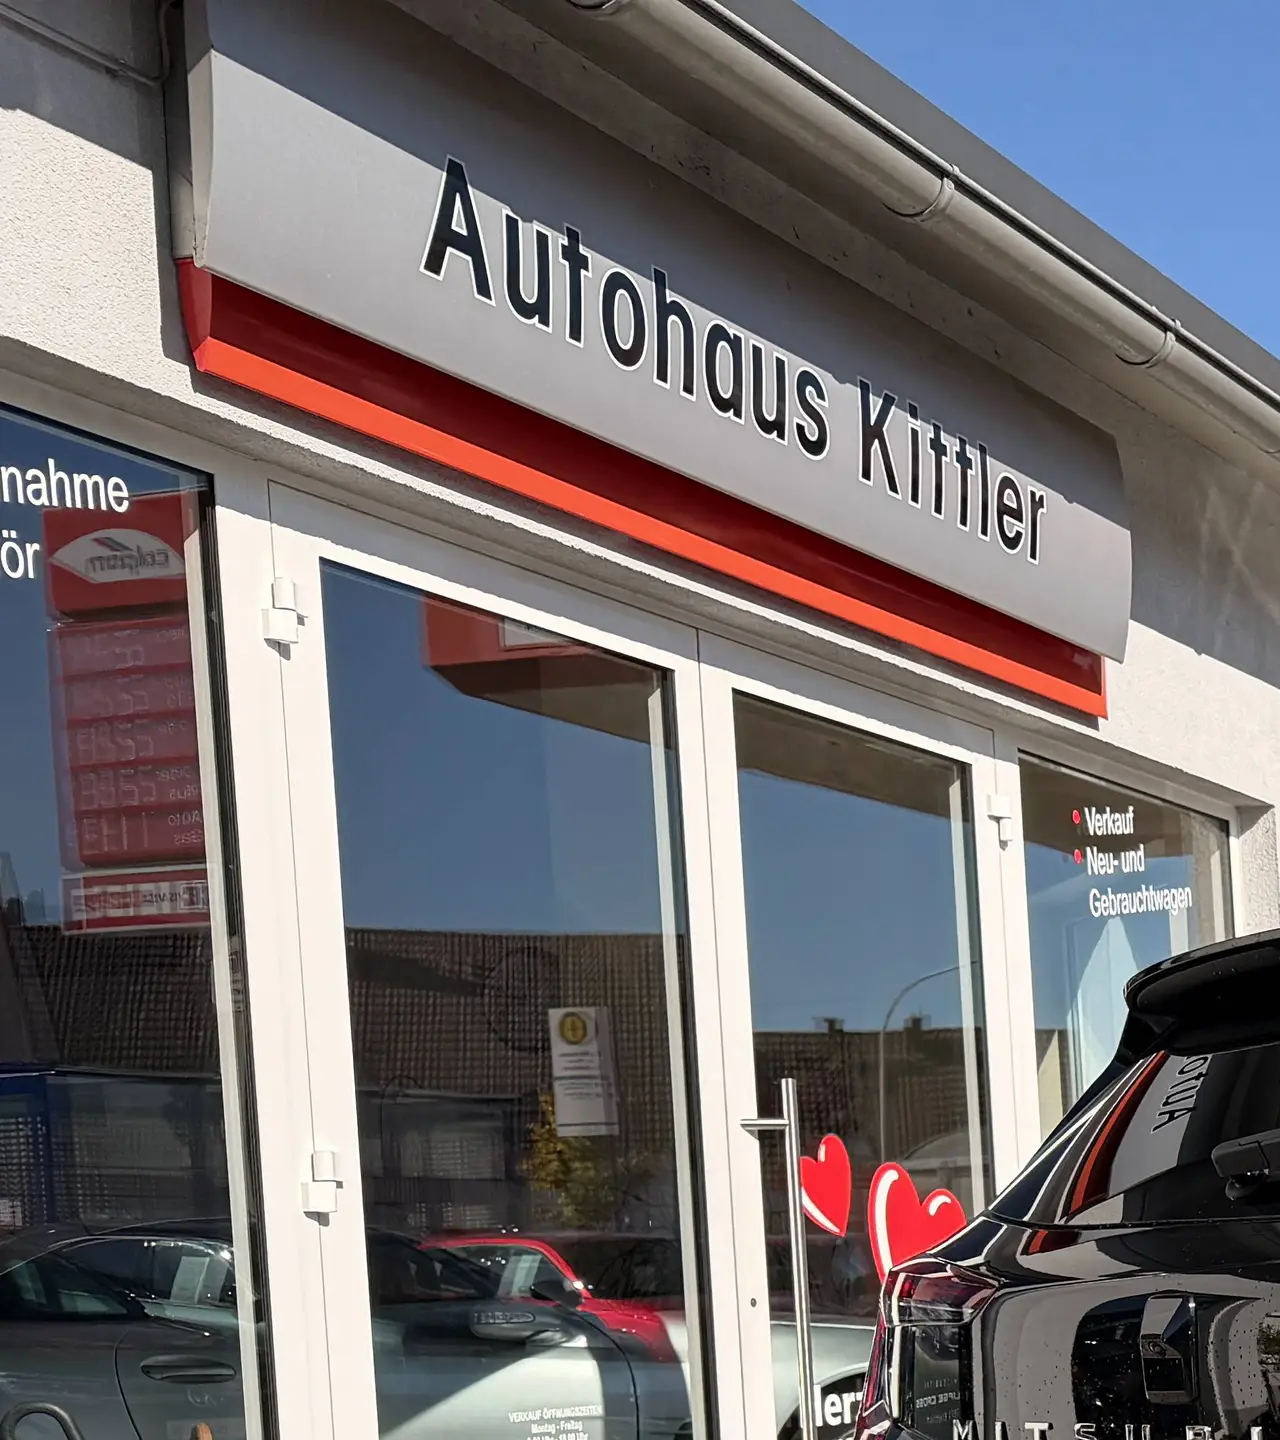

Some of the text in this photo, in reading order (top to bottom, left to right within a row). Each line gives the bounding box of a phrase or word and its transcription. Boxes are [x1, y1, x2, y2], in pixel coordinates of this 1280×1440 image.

[419, 154, 1047, 566] Autohaus Kittler
[1083, 805, 1135, 836] Verkauf
[1085, 843, 1145, 876] Neu- und
[1089, 884, 1193, 918] Gebrauchtwagen
[508, 1410, 541, 1422] VERKAUF
